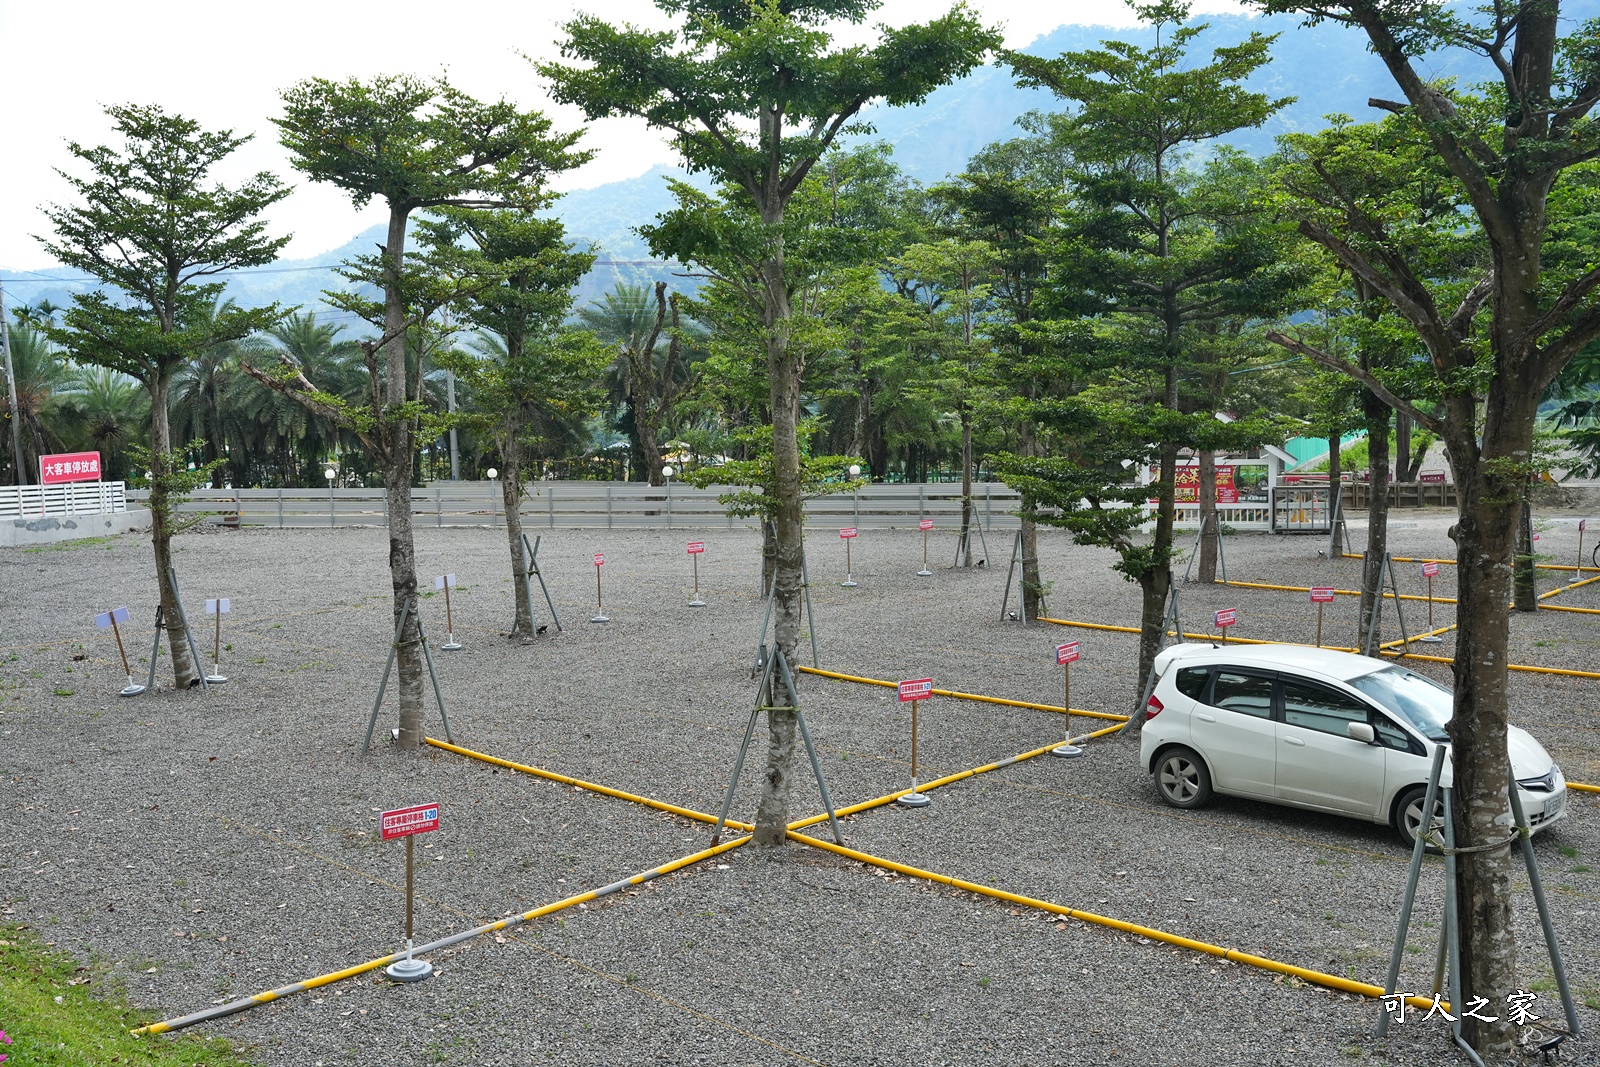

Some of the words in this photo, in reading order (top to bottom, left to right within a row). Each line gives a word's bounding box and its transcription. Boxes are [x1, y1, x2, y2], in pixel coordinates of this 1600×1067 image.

[45, 460, 98, 476] 大客車停放處
